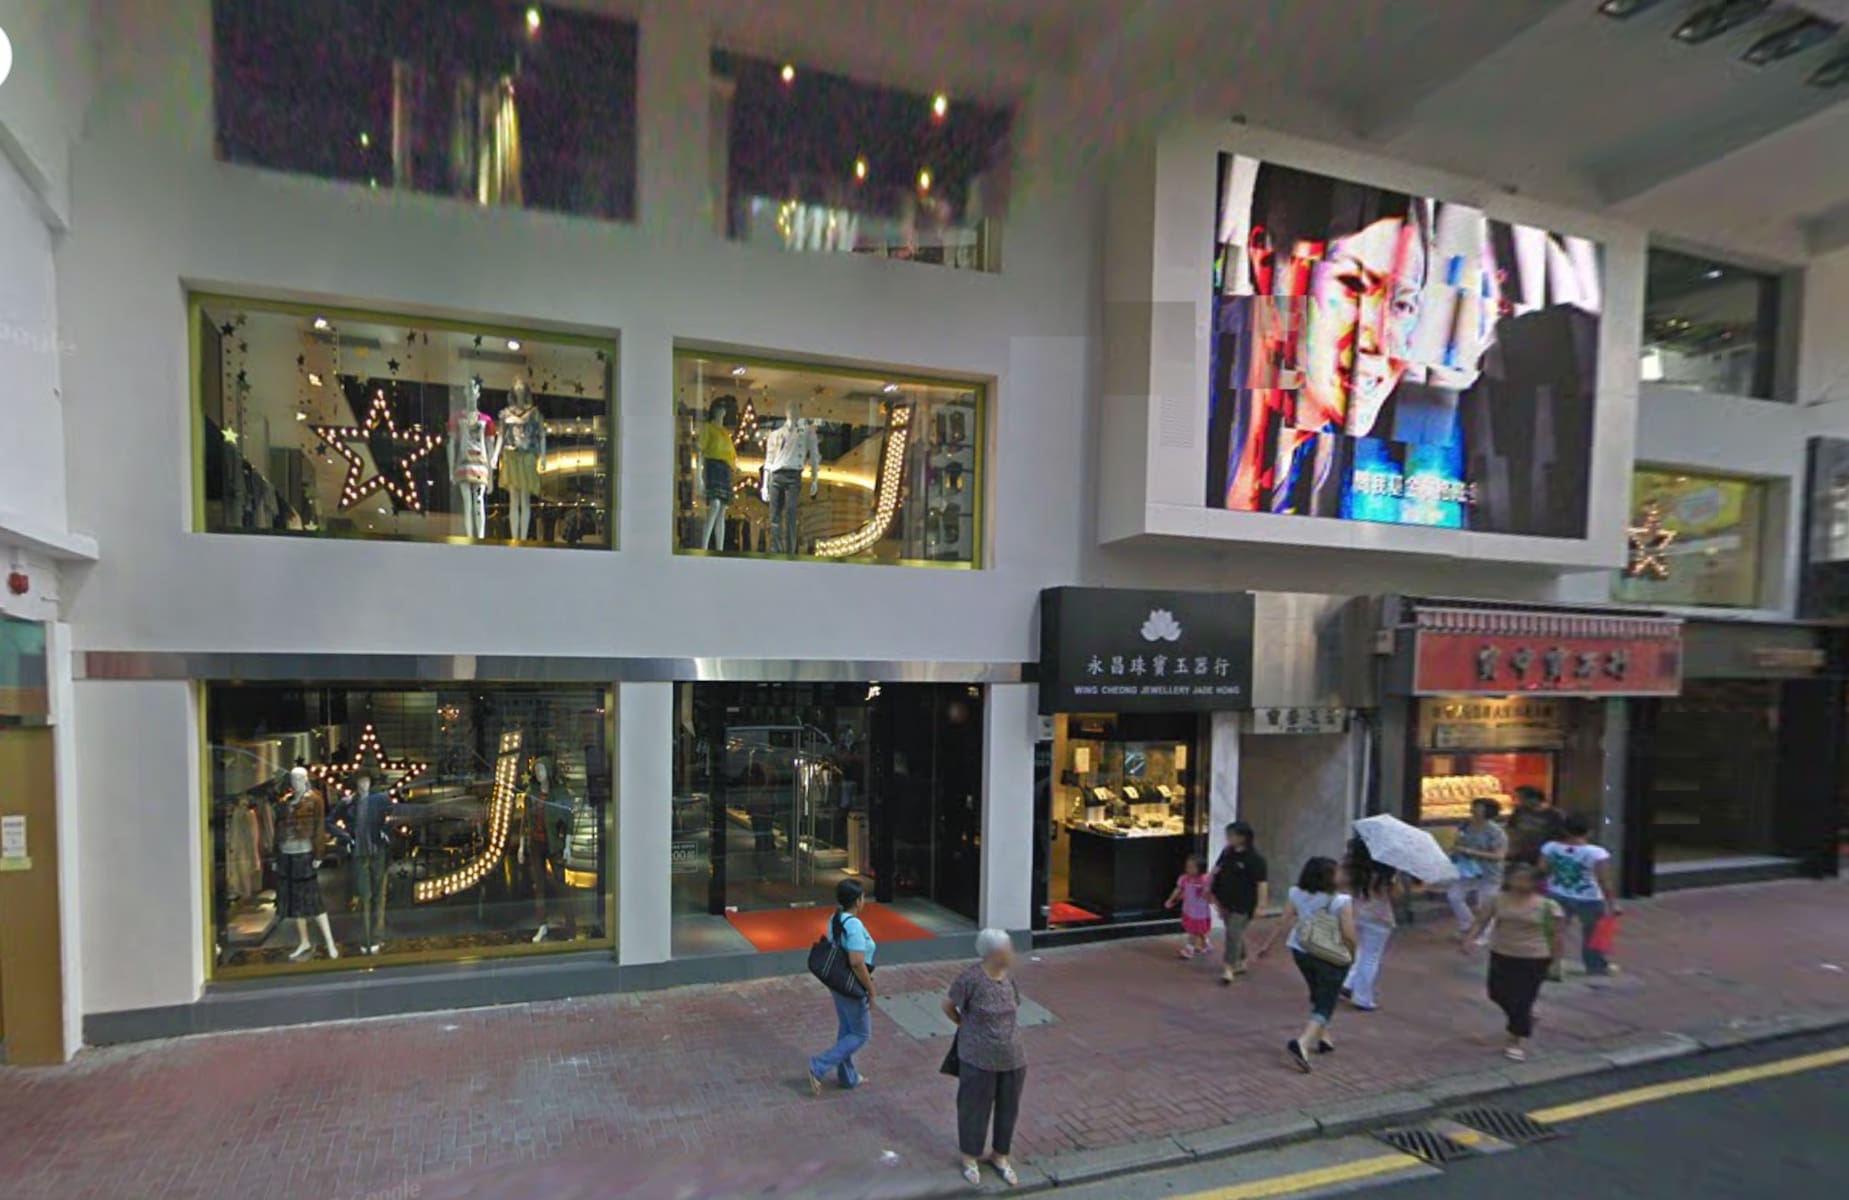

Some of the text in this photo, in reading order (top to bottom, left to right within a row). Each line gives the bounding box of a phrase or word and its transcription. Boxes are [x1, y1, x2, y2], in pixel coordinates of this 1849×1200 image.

[1087, 654, 1231, 677] 永昌珠寶玉器行
[1074, 685, 1240, 695] WING CHEONG JEWELLERY JADE HONG
